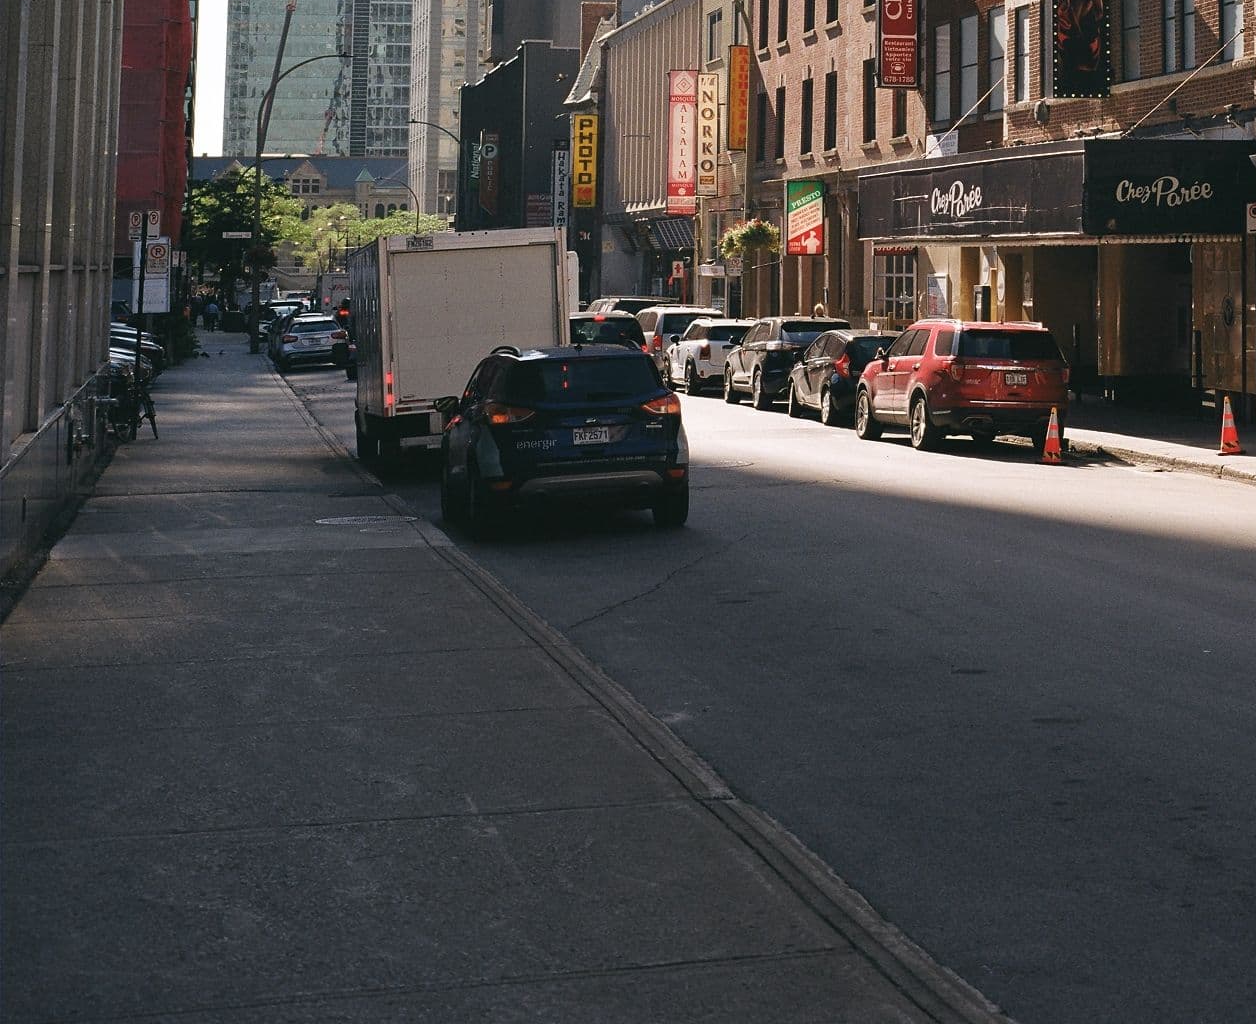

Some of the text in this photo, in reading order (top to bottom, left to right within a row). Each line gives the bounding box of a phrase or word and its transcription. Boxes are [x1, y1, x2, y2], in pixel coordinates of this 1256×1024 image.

[701, 90, 715, 173] NORKO
[578, 119, 593, 185] PHOTO
[791, 190, 820, 209] PRESTO
[931, 180, 982, 218] Chez Parée
[1116, 176, 1213, 207] Chez Parée
